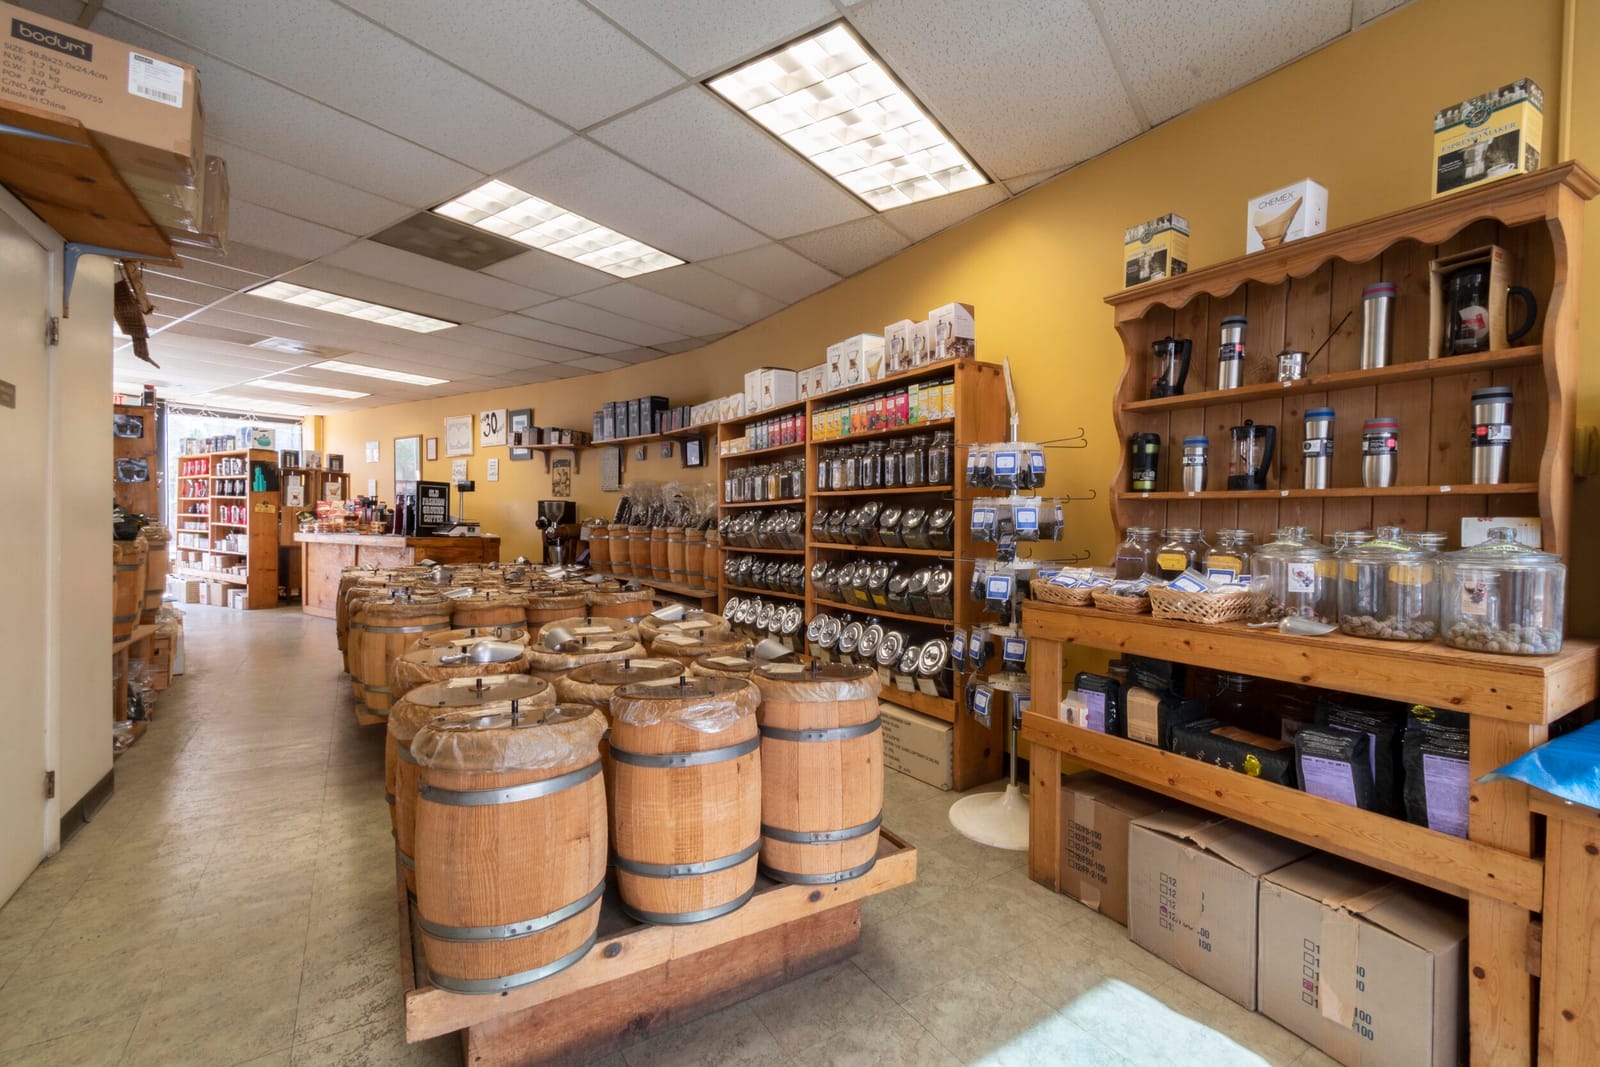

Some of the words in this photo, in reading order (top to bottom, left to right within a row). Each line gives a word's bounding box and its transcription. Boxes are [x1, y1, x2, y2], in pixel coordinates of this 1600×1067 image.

[19, 23, 86, 55] bodum
[49, 65, 60, 75] kg
[49, 73, 60, 83] kg
[1, 86, 28, 99] Made
[29, 95, 38, 103] in
[39, 98, 67, 110] China
[1483, 122, 1517, 138] MAKER
[1258, 191, 1296, 210] CHEMEX
[482, 411, 498, 437] 30
[428, 489, 440, 498] OLD
[422, 497, 446, 506] FASHION
[422, 506, 445, 515] GROUND
[423, 514, 444, 523] COFFEE
